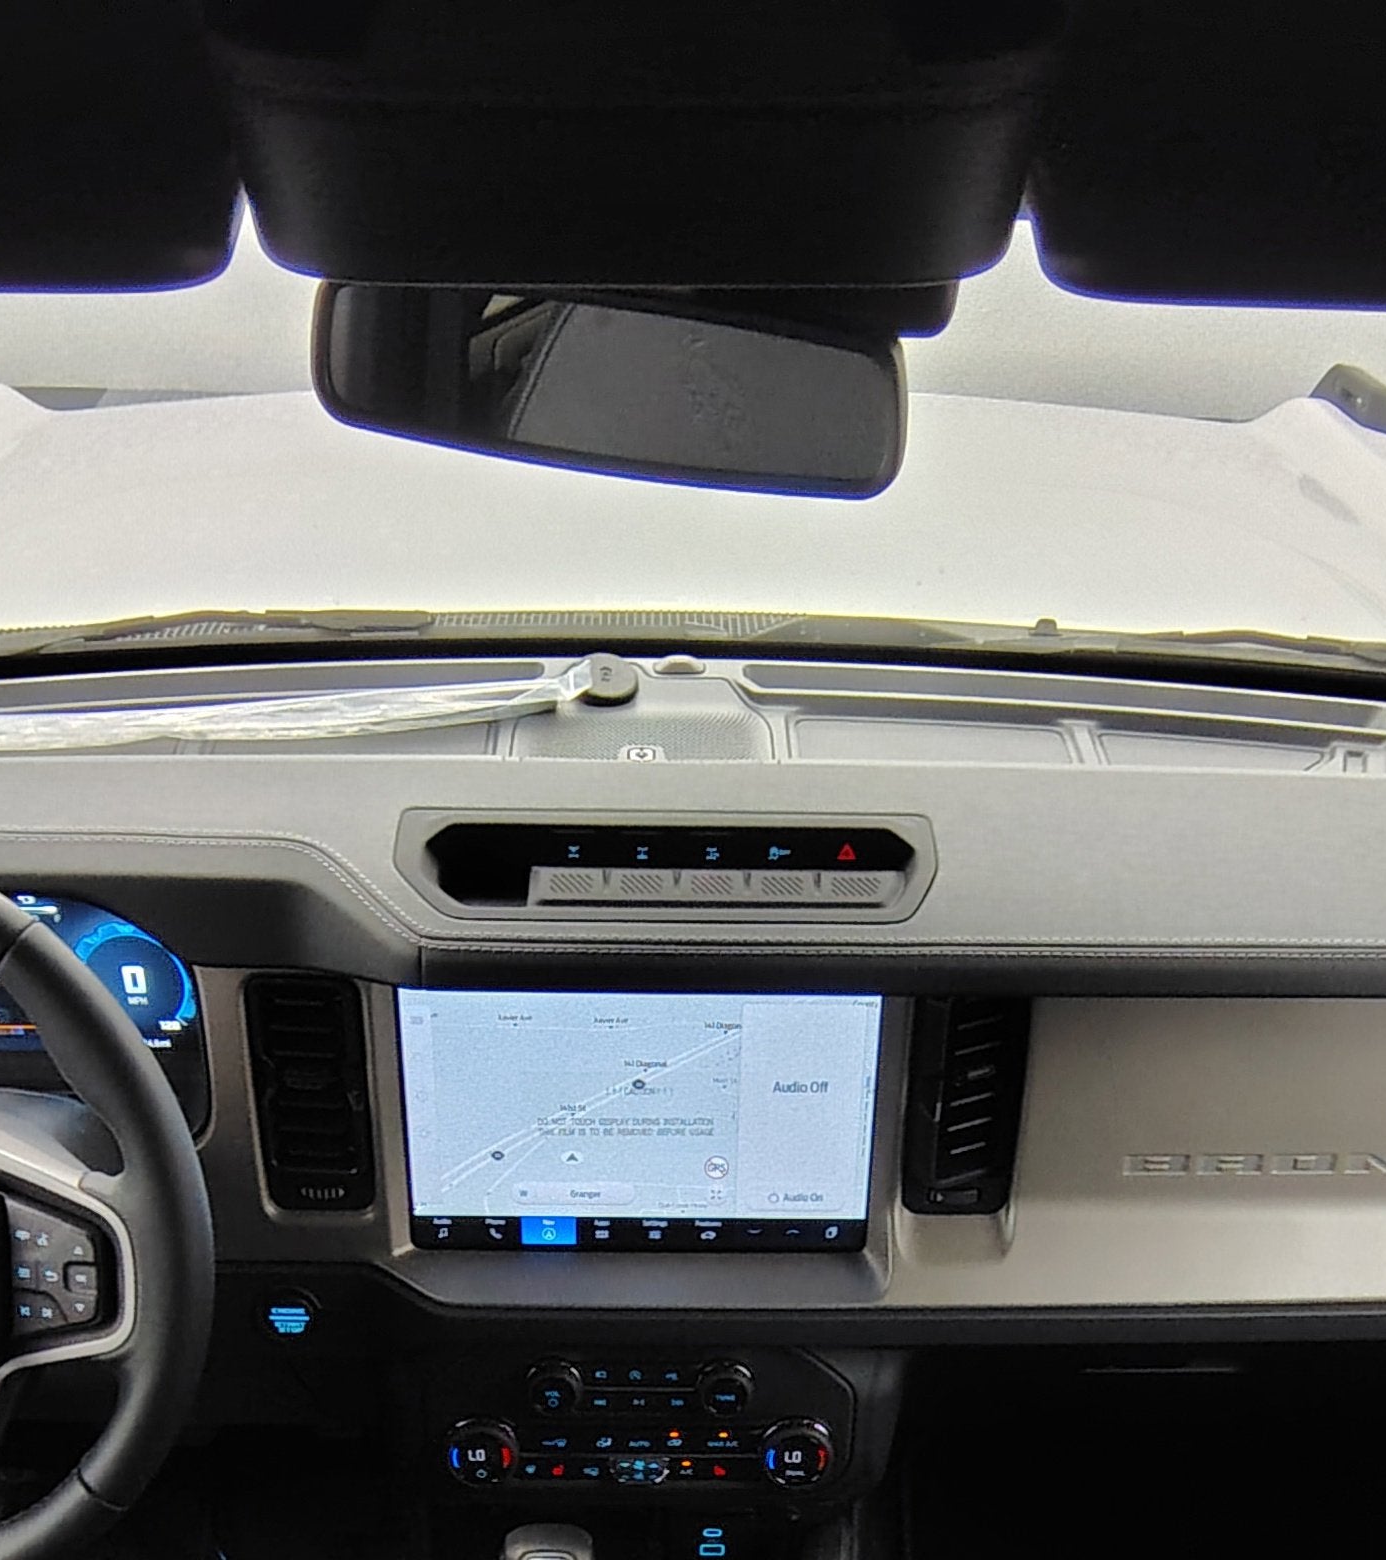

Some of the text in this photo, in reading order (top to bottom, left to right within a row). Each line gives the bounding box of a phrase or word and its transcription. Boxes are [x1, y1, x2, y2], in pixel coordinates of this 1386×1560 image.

[121, 965, 148, 994] 0
[772, 1081, 830, 1094] Audio Off
[570, 1189, 601, 1199] Granger
[782, 1193, 823, 1202] Audio On
